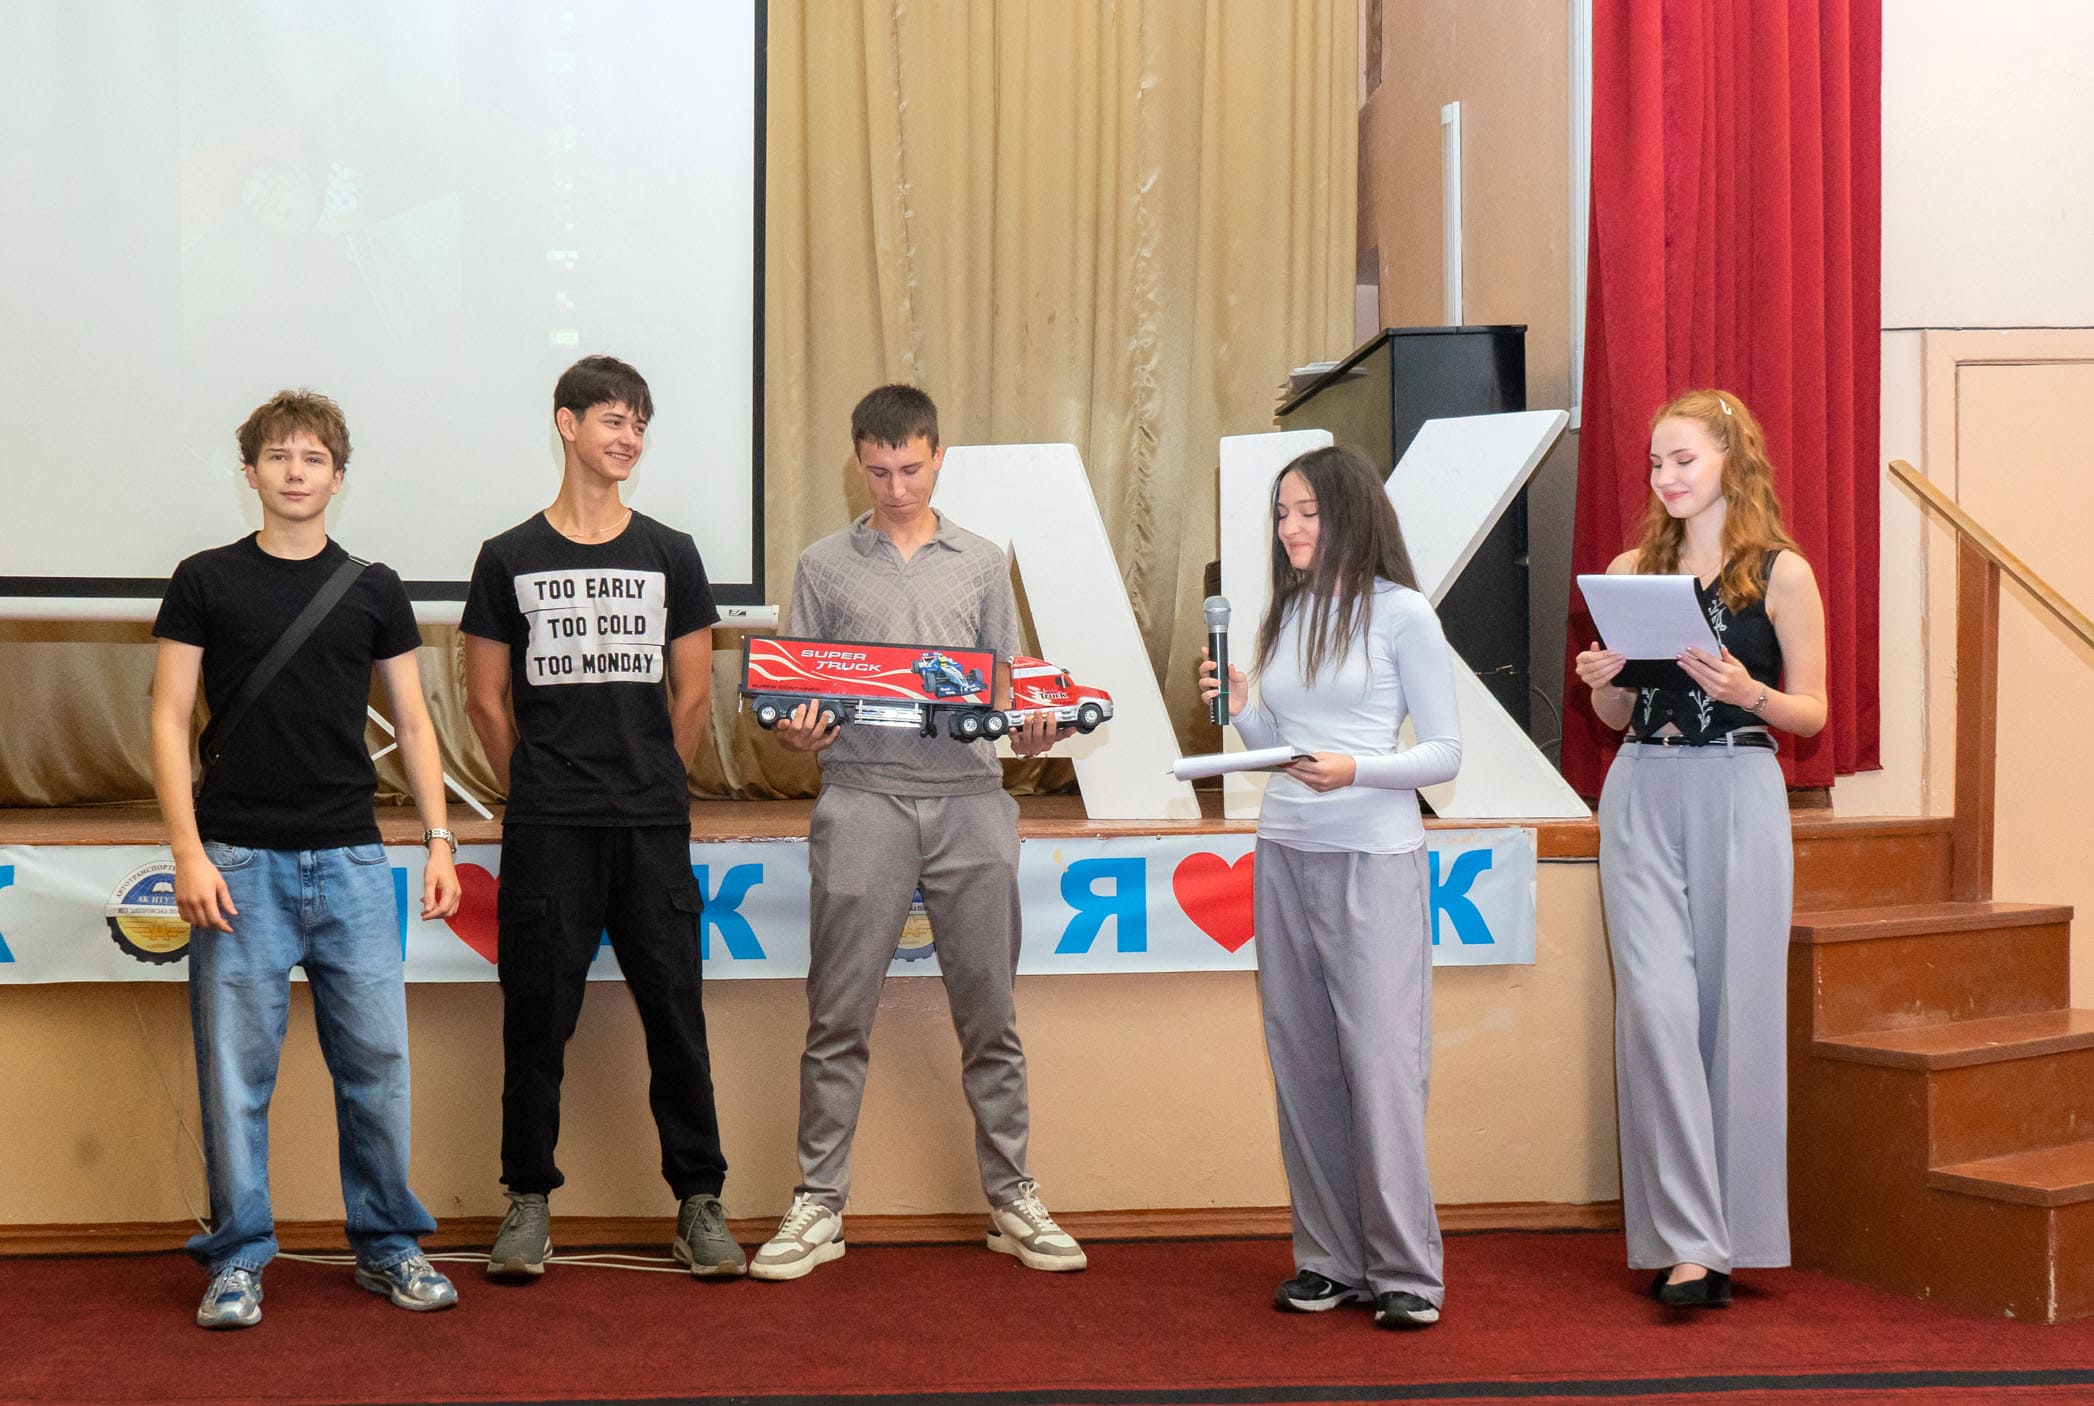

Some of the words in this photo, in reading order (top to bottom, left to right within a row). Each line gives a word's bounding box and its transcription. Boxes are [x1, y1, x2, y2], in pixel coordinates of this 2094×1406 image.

[534, 578, 576, 601] TOO
[585, 577, 646, 599] EARLY
[547, 616, 588, 639] TOO
[597, 614, 647, 636] COLD
[533, 655, 573, 677] TOO
[582, 652, 653, 674] MONDAY
[800, 649, 868, 661] SUPER
[816, 660, 883, 672] TRUCK
[1053, 856, 1148, 954] Я
[1427, 848, 1496, 946] К
